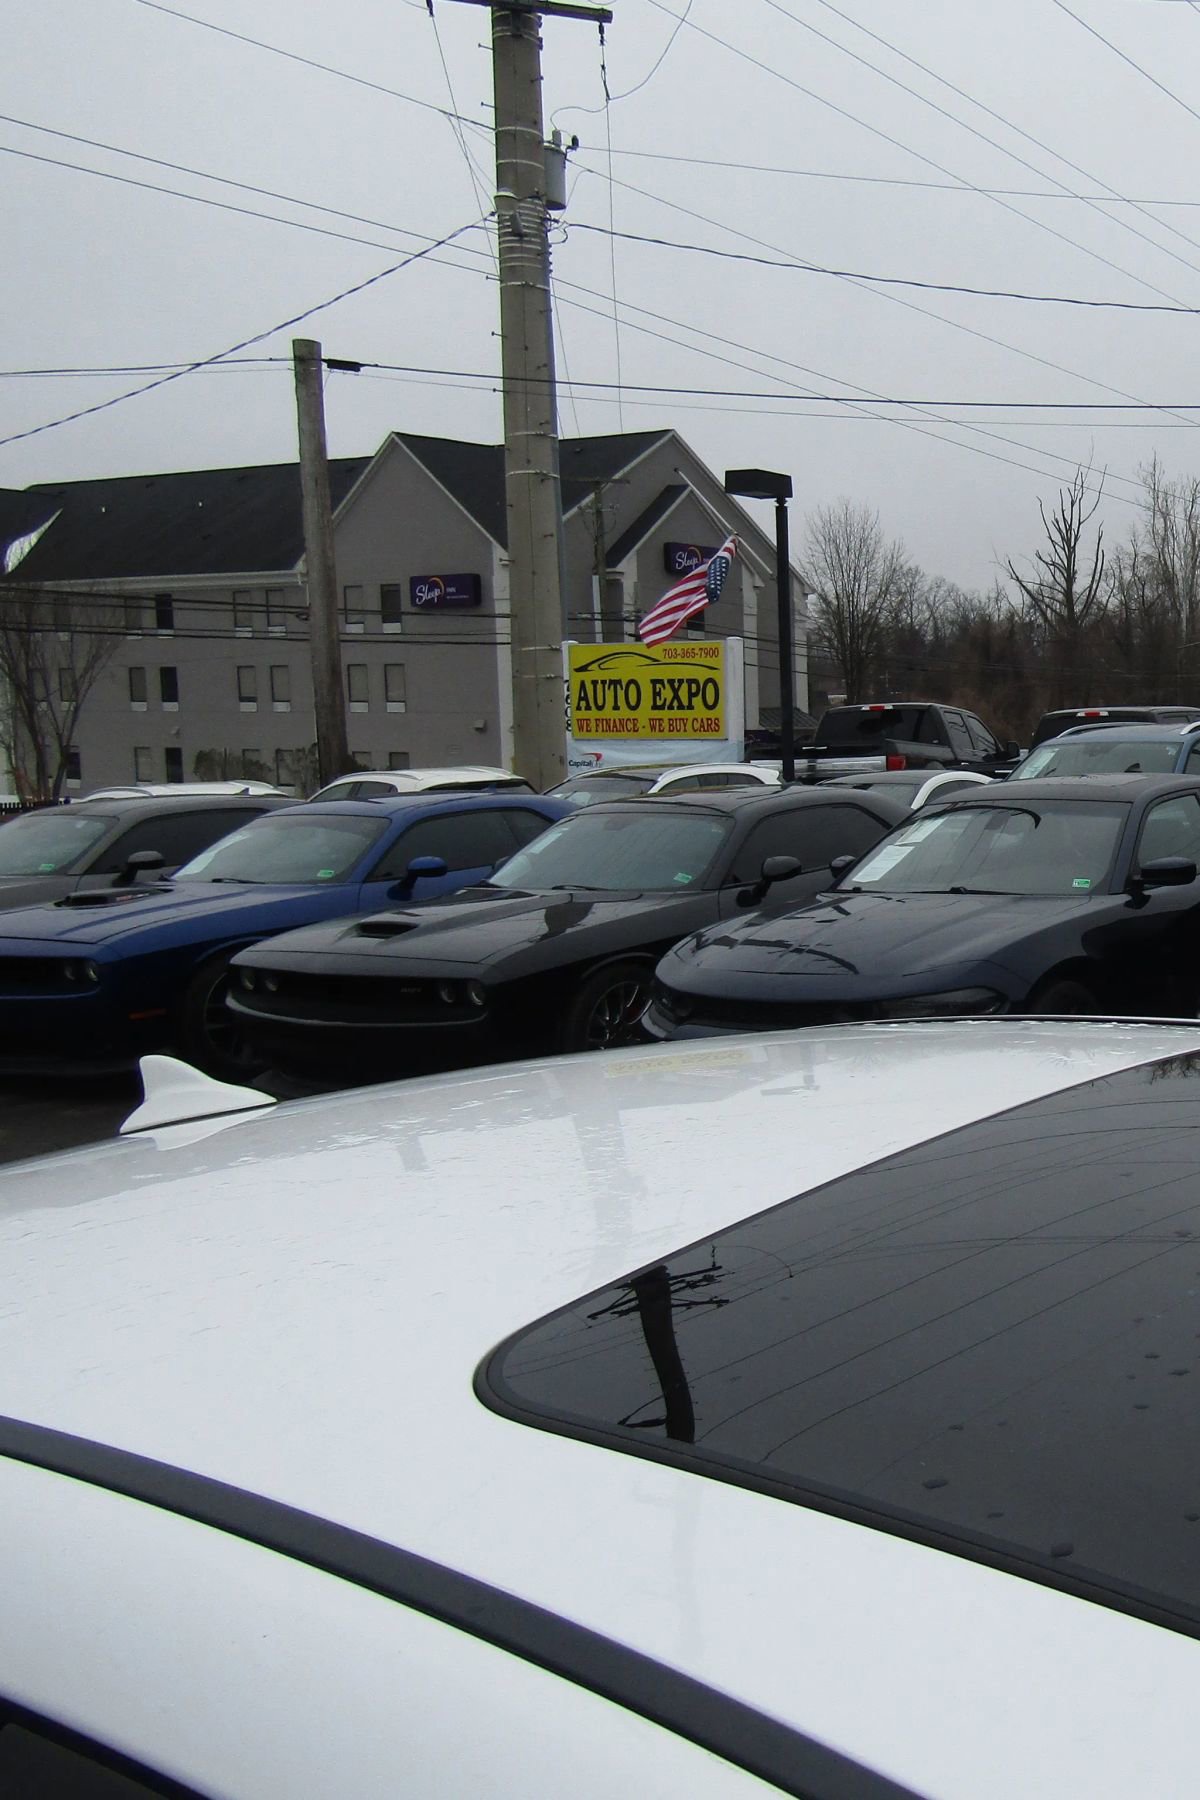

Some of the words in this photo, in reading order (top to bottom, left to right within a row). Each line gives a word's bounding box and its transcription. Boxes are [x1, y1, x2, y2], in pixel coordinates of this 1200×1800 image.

[675, 552, 700, 570] Sleep
[415, 584, 442, 604] Sleep
[662, 647, 720, 659] 703-365-7900
[575, 678, 642, 712] AUTO
[650, 677, 720, 711] EXPO
[576, 718, 592, 733] WE
[594, 718, 640, 733] FINANCE
[648, 718, 665, 733] WE
[667, 718, 688, 733] BUY
[691, 717, 721, 733] CARS
[568, 759, 593, 768] Capital
